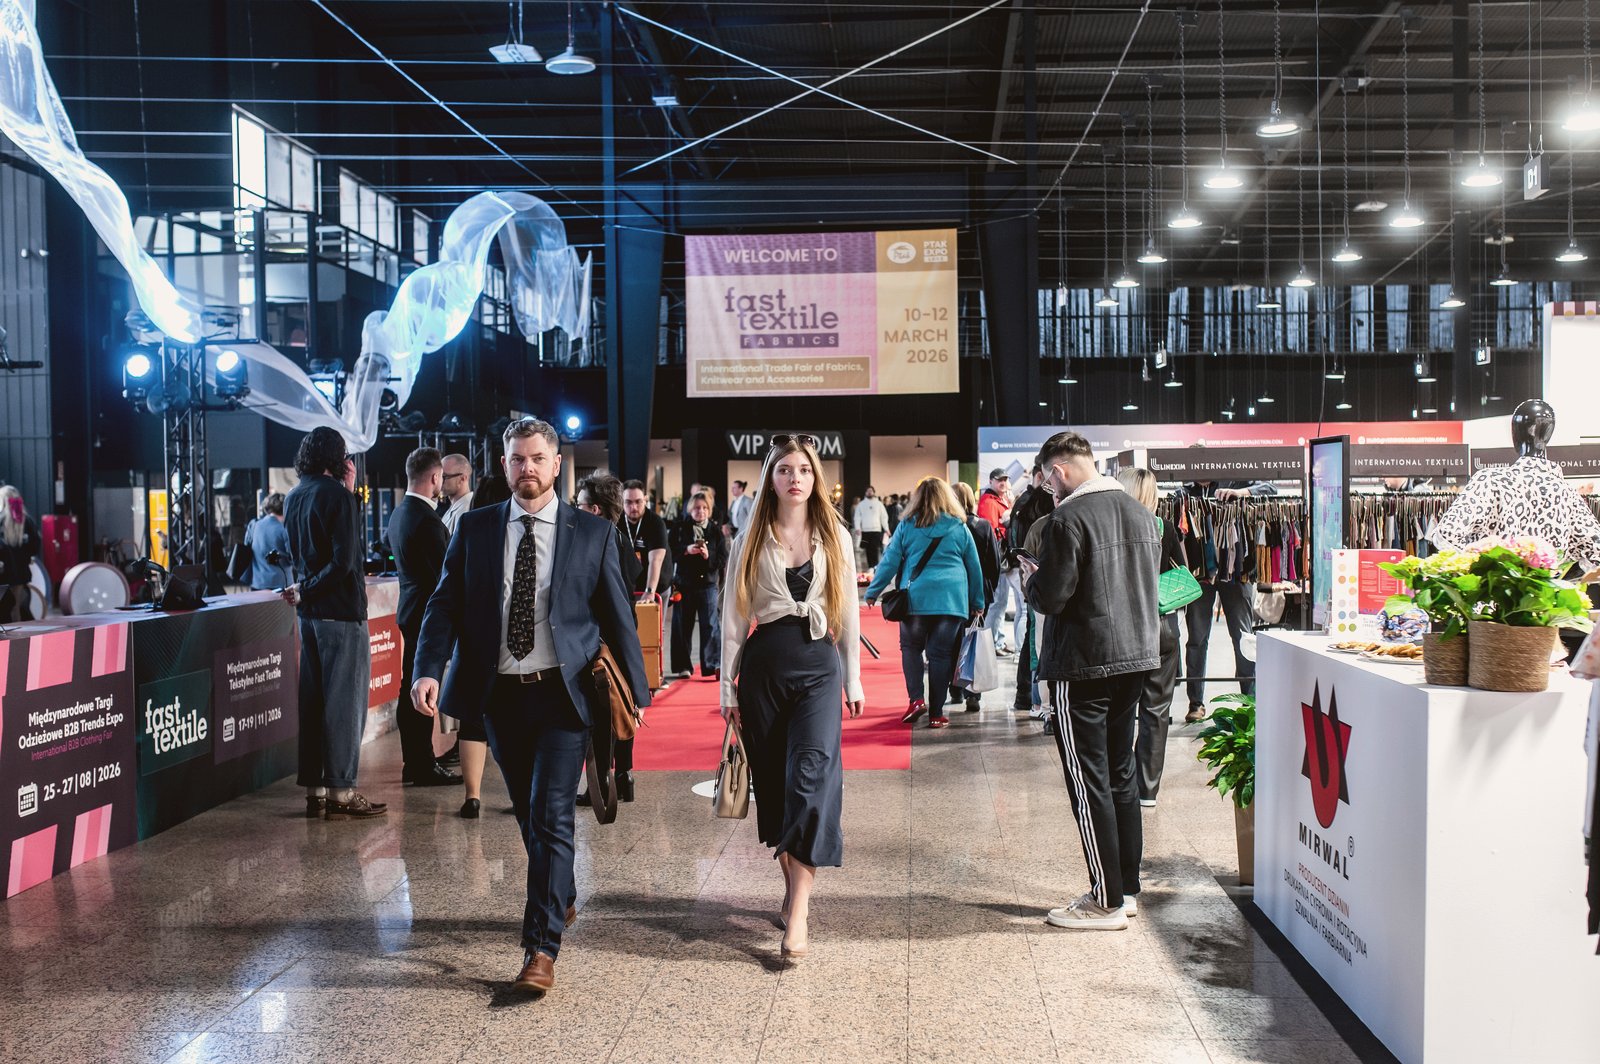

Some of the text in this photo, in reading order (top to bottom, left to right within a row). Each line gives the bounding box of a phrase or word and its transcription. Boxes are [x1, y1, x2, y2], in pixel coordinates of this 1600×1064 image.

[1527, 165, 1538, 190] D1
[724, 247, 838, 263] WELCOME TO
[923, 240, 948, 248] PTAK
[923, 248, 948, 256] EXPO
[725, 287, 786, 312] fast
[737, 303, 839, 330] textile
[905, 307, 948, 321] 10-12
[743, 336, 836, 346] FABRICS
[884, 329, 948, 343] MARCH
[907, 349, 948, 363] 2026
[701, 362, 864, 373] International Trade Fair of Fabrics,
[701, 374, 824, 385] Knitwear and Accessories
[729, 434, 764, 454] VIP
[1191, 462, 1258, 470] INTERNATIONAL
[1262, 461, 1301, 469] TEXTILES
[1355, 458, 1464, 466] INTERNATIONAL TEXTILES
[227, 652, 282, 676] Międzynarodowe Targi
[229, 667, 281, 690] Tekstylne Fast Textile
[28, 694, 113, 727] Międzynarodowe Targi
[145, 696, 181, 734] fast
[268, 707, 282, 723] 2026
[18, 712, 124, 750] Odzieżowe B2B Trends Expo
[152, 709, 207, 755] textile
[31, 730, 113, 761] International B2B Clothing Fair
[98, 762, 121, 783] 2026
[1299, 822, 1350, 880] MIRWAL
[1298, 862, 1349, 919] PRODUCENT DZIANIN
[1284, 868, 1309, 900] DRUKARNIA
[1310, 893, 1333, 926] CYFROWA
[1336, 917, 1367, 959] ROTACYJNA
[1295, 899, 1319, 932] SZWALNIA
[1322, 925, 1352, 967] FARBIARNIA
